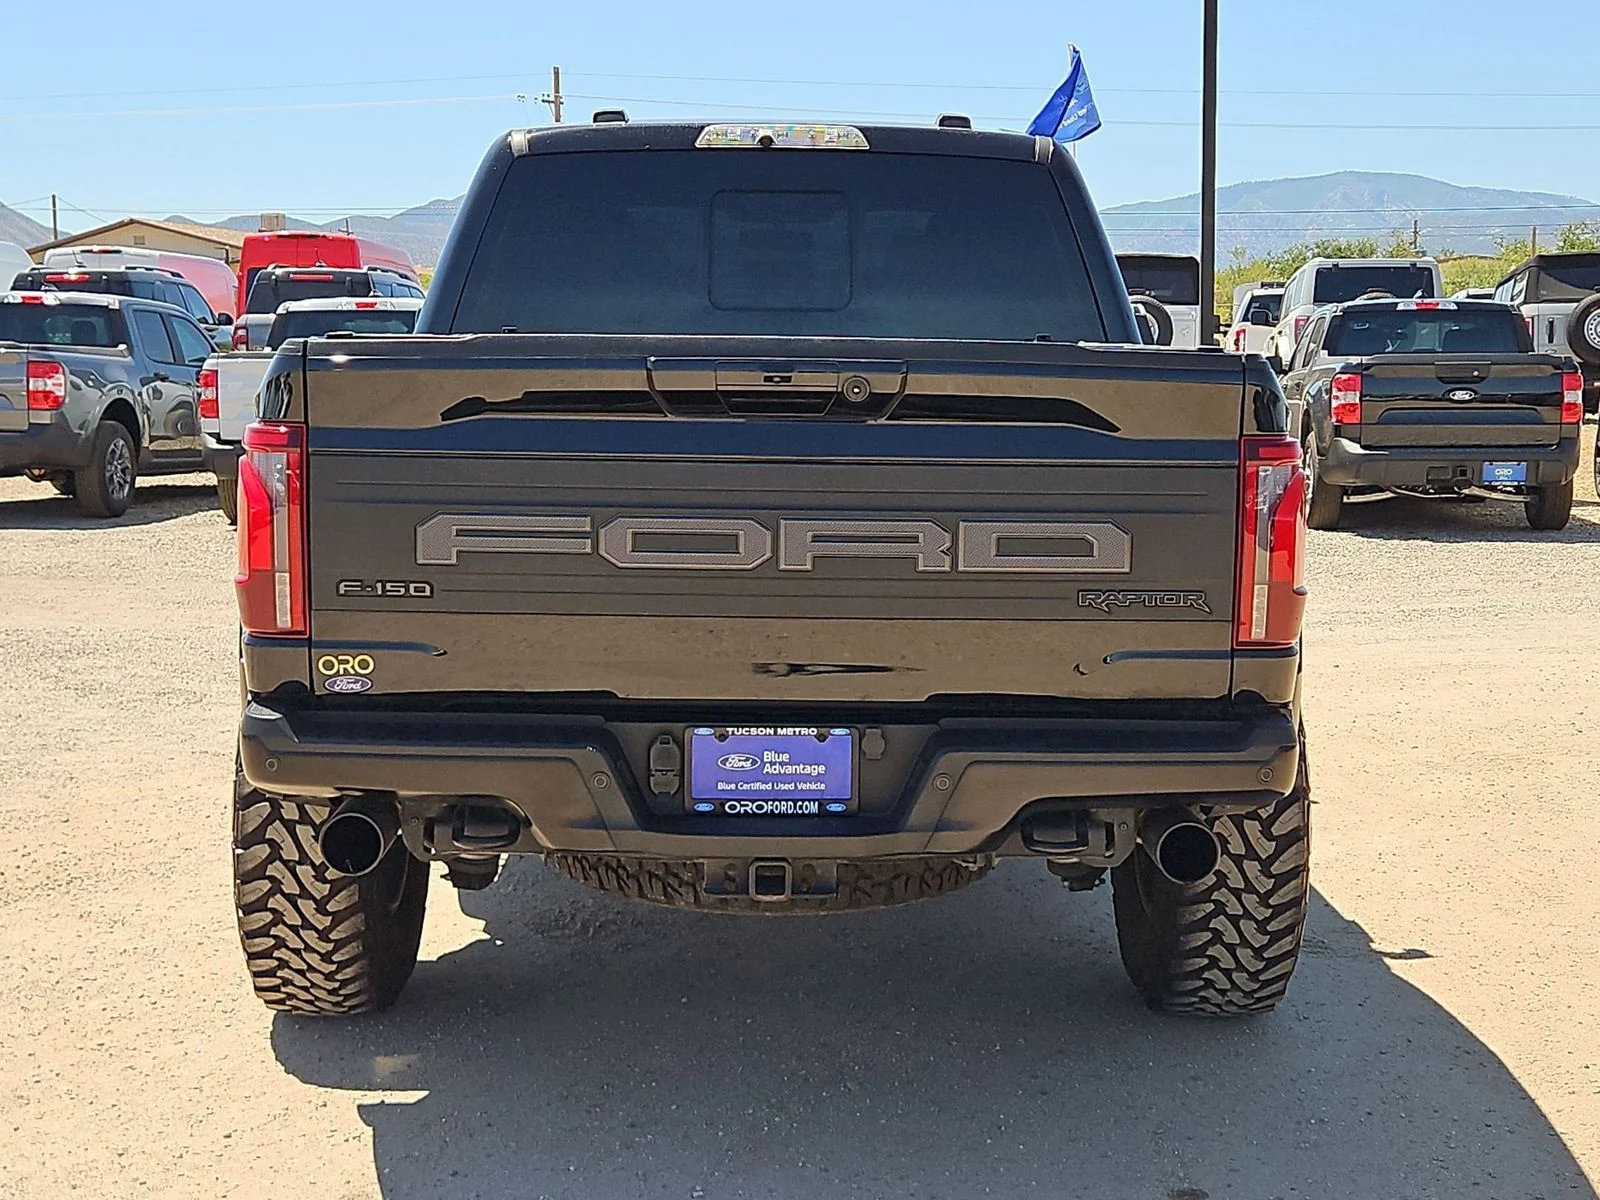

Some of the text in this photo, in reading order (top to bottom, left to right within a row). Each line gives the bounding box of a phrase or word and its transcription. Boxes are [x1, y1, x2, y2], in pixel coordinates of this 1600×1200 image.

[415, 510, 1133, 574] FORD
[338, 580, 433, 597] F-150
[1078, 591, 1212, 614] RAPTOR
[317, 654, 375, 675] ORO
[726, 727, 818, 736] TUCSON METRO
[763, 750, 790, 763] Blue
[763, 763, 826, 776] Advantage
[717, 781, 826, 790] Blue Certified Used Vehicle
